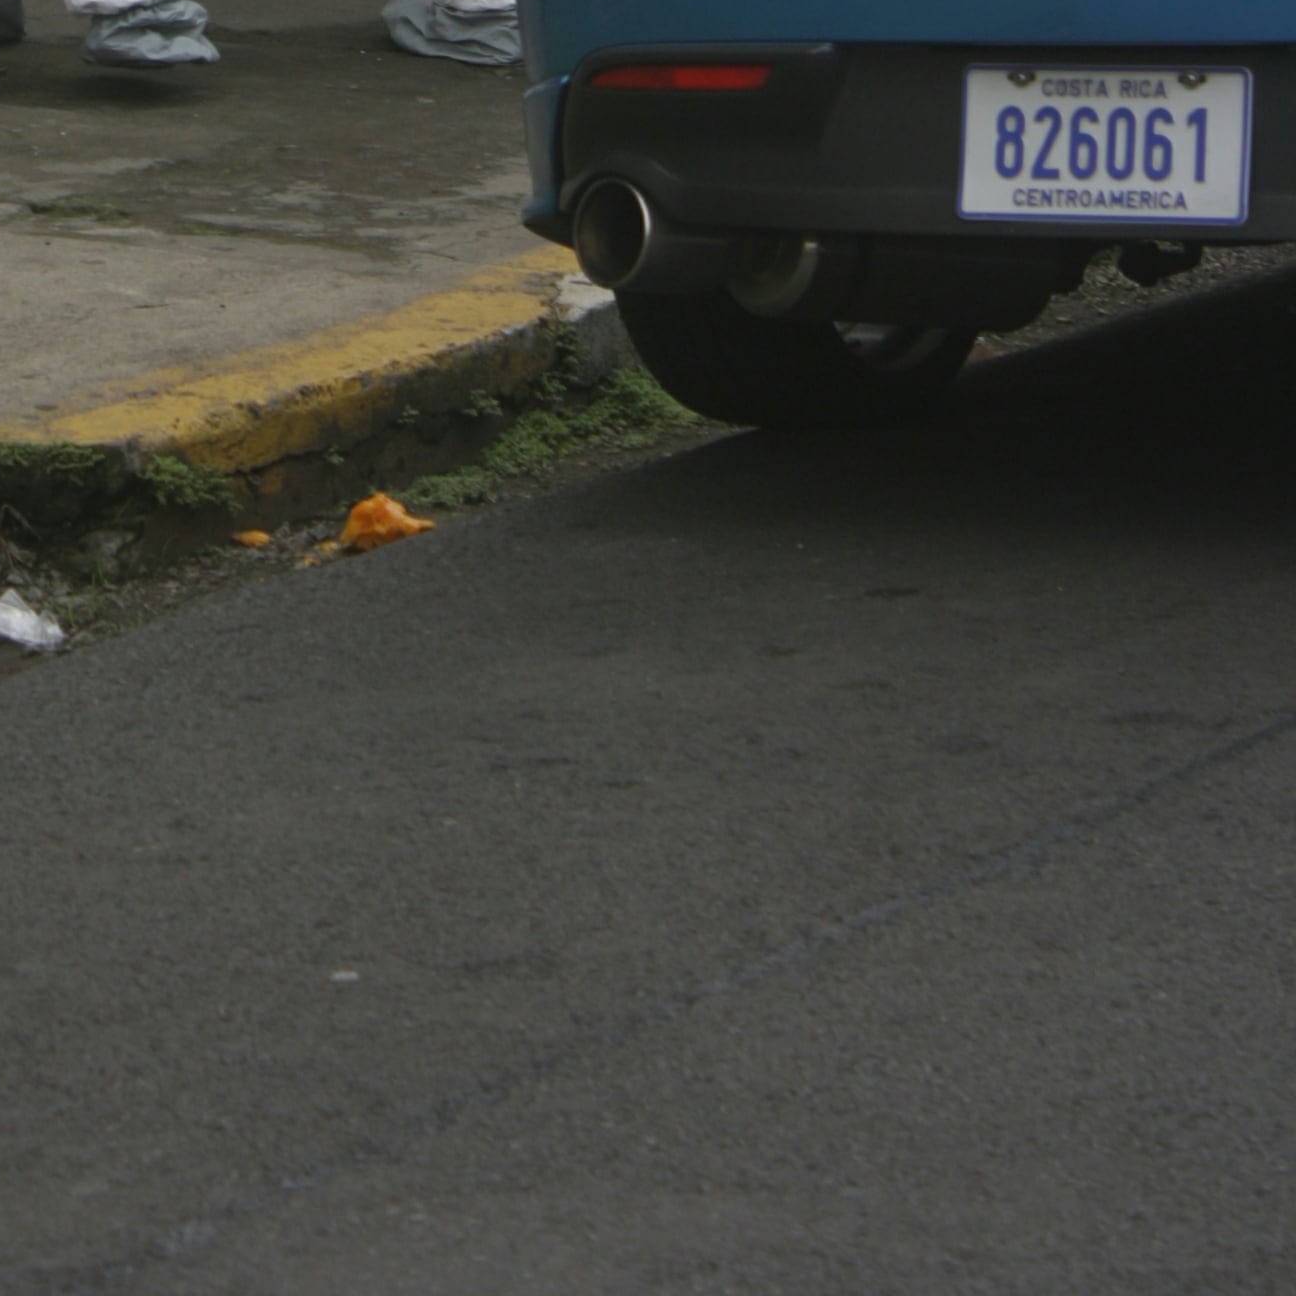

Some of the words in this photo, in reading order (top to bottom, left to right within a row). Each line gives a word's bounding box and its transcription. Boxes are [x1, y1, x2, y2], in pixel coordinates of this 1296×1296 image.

[1041, 78, 1109, 98] COSTA
[1119, 80, 1168, 99] RICA
[994, 105, 1208, 184] 826061
[1012, 188, 1188, 211] CENTROAMERICA
